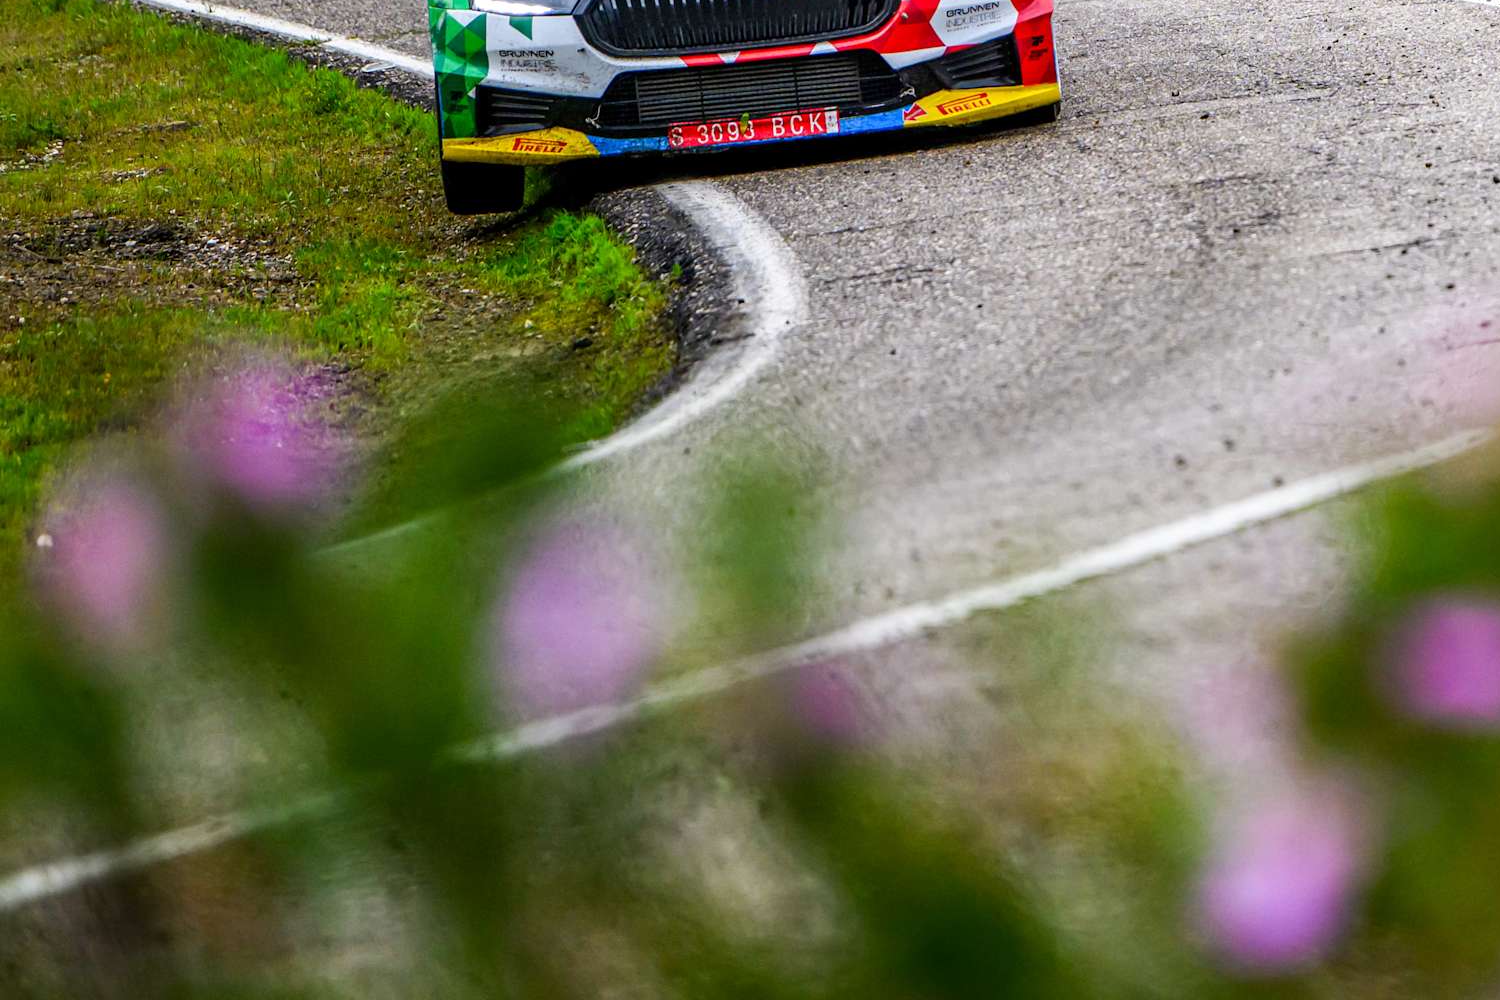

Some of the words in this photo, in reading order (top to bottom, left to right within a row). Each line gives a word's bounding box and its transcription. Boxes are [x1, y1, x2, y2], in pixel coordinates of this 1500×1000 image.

[946, 1, 1000, 18] BRUNNEN
[498, 49, 555, 58] BRUNNEN
[936, 92, 992, 115] PIRELLI
[772, 111, 825, 137] BCK
[512, 137, 568, 153] PIRELLI
